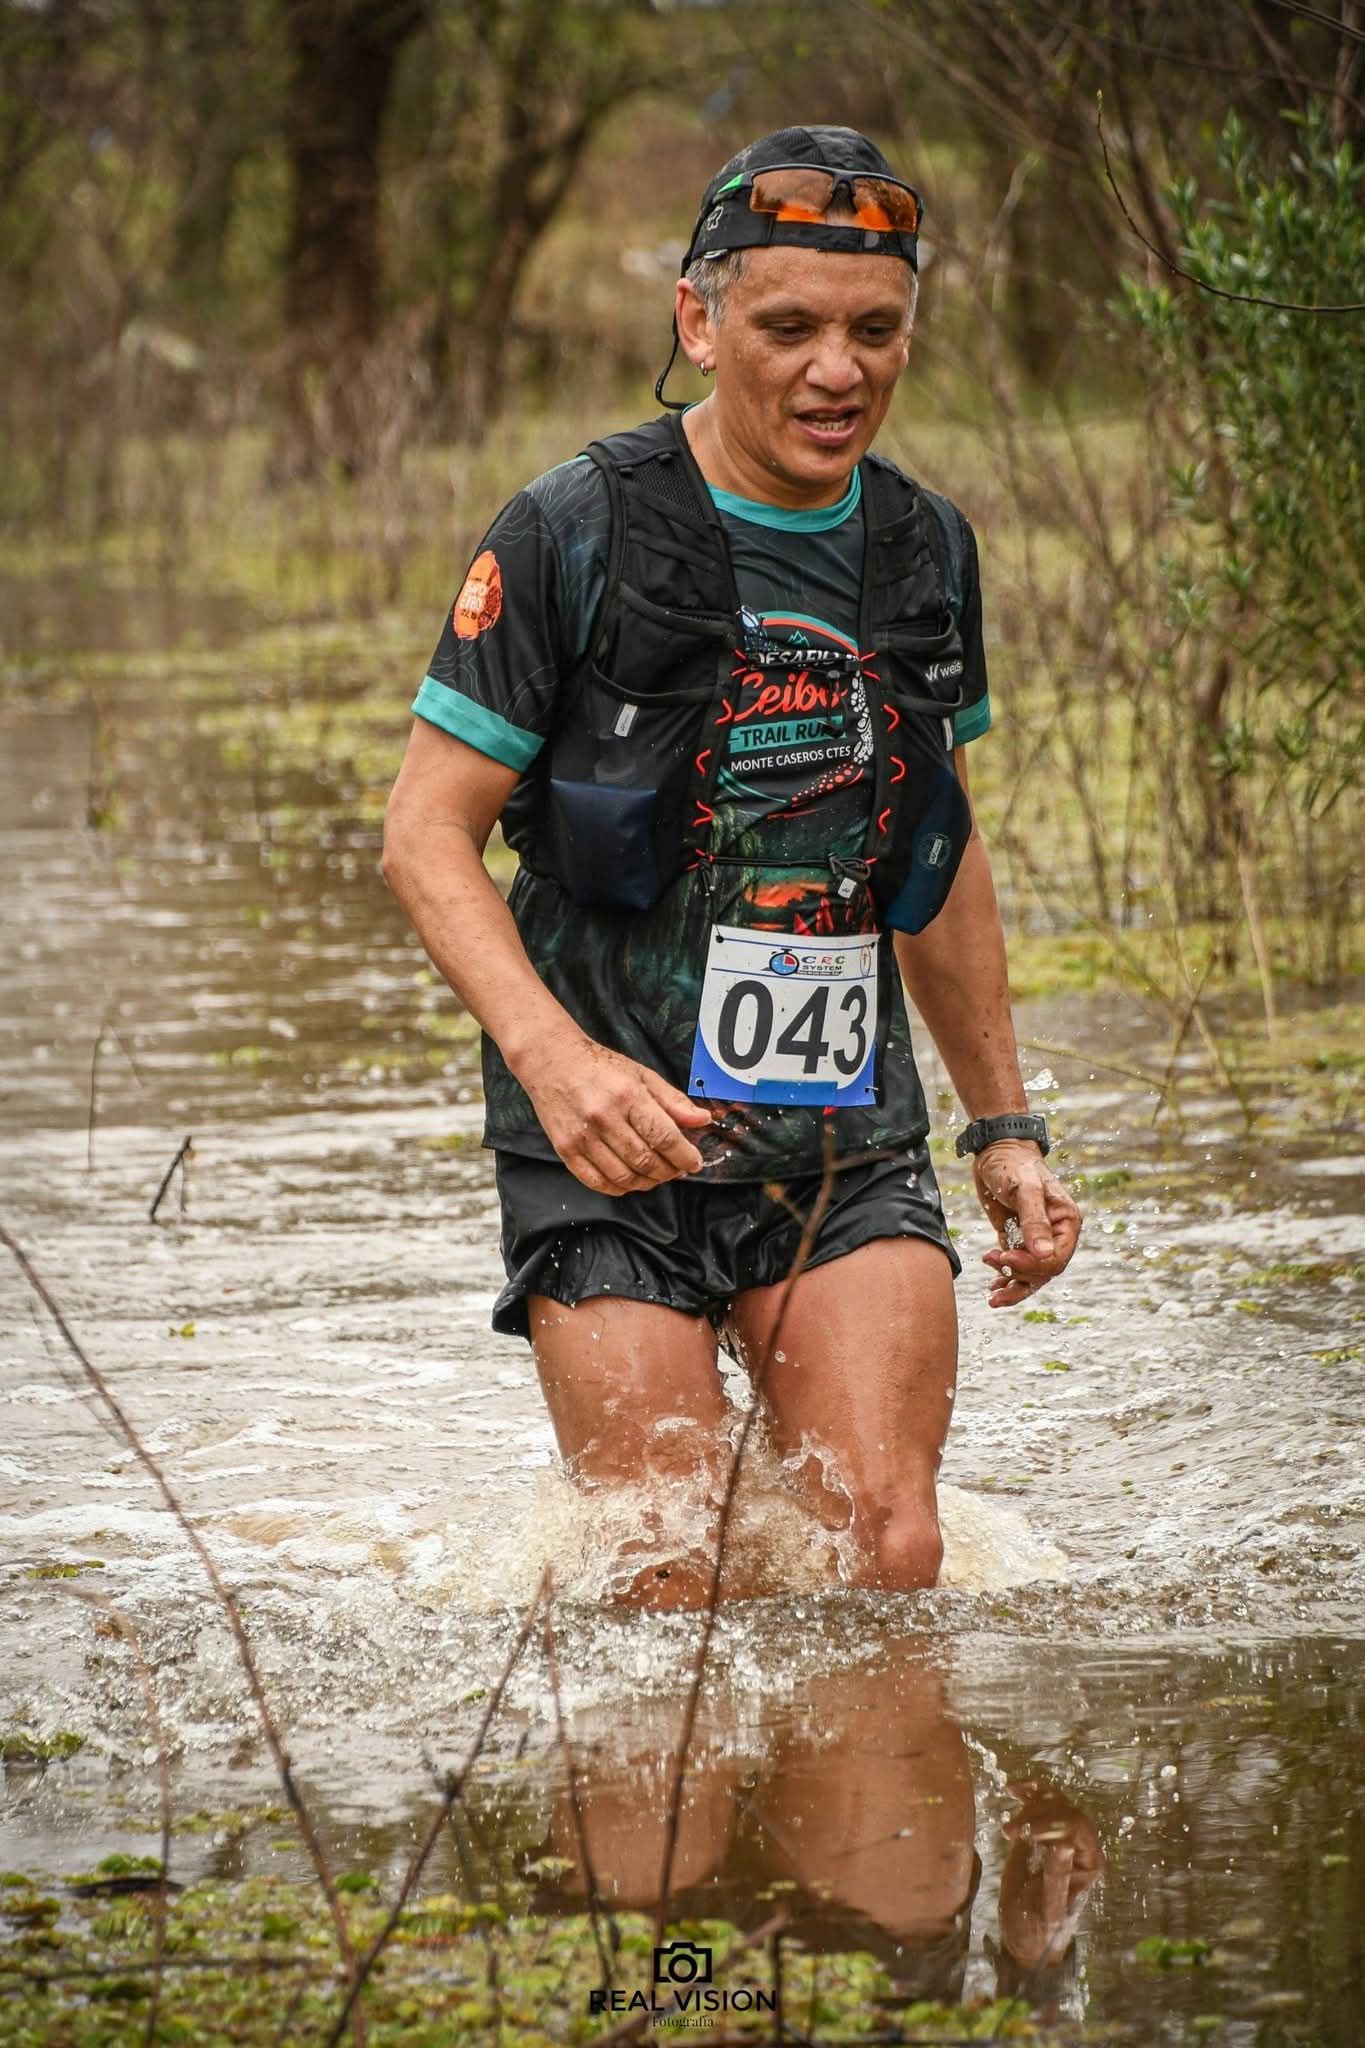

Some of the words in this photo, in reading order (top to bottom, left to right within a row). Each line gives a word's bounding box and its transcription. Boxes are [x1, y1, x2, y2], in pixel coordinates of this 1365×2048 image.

[739, 725, 792, 748] TRAIL
[730, 757, 774, 772] MONTE
[776, 750, 824, 767] CASEROS
[826, 745, 852, 759] CTES
[718, 980, 867, 1075] 043
